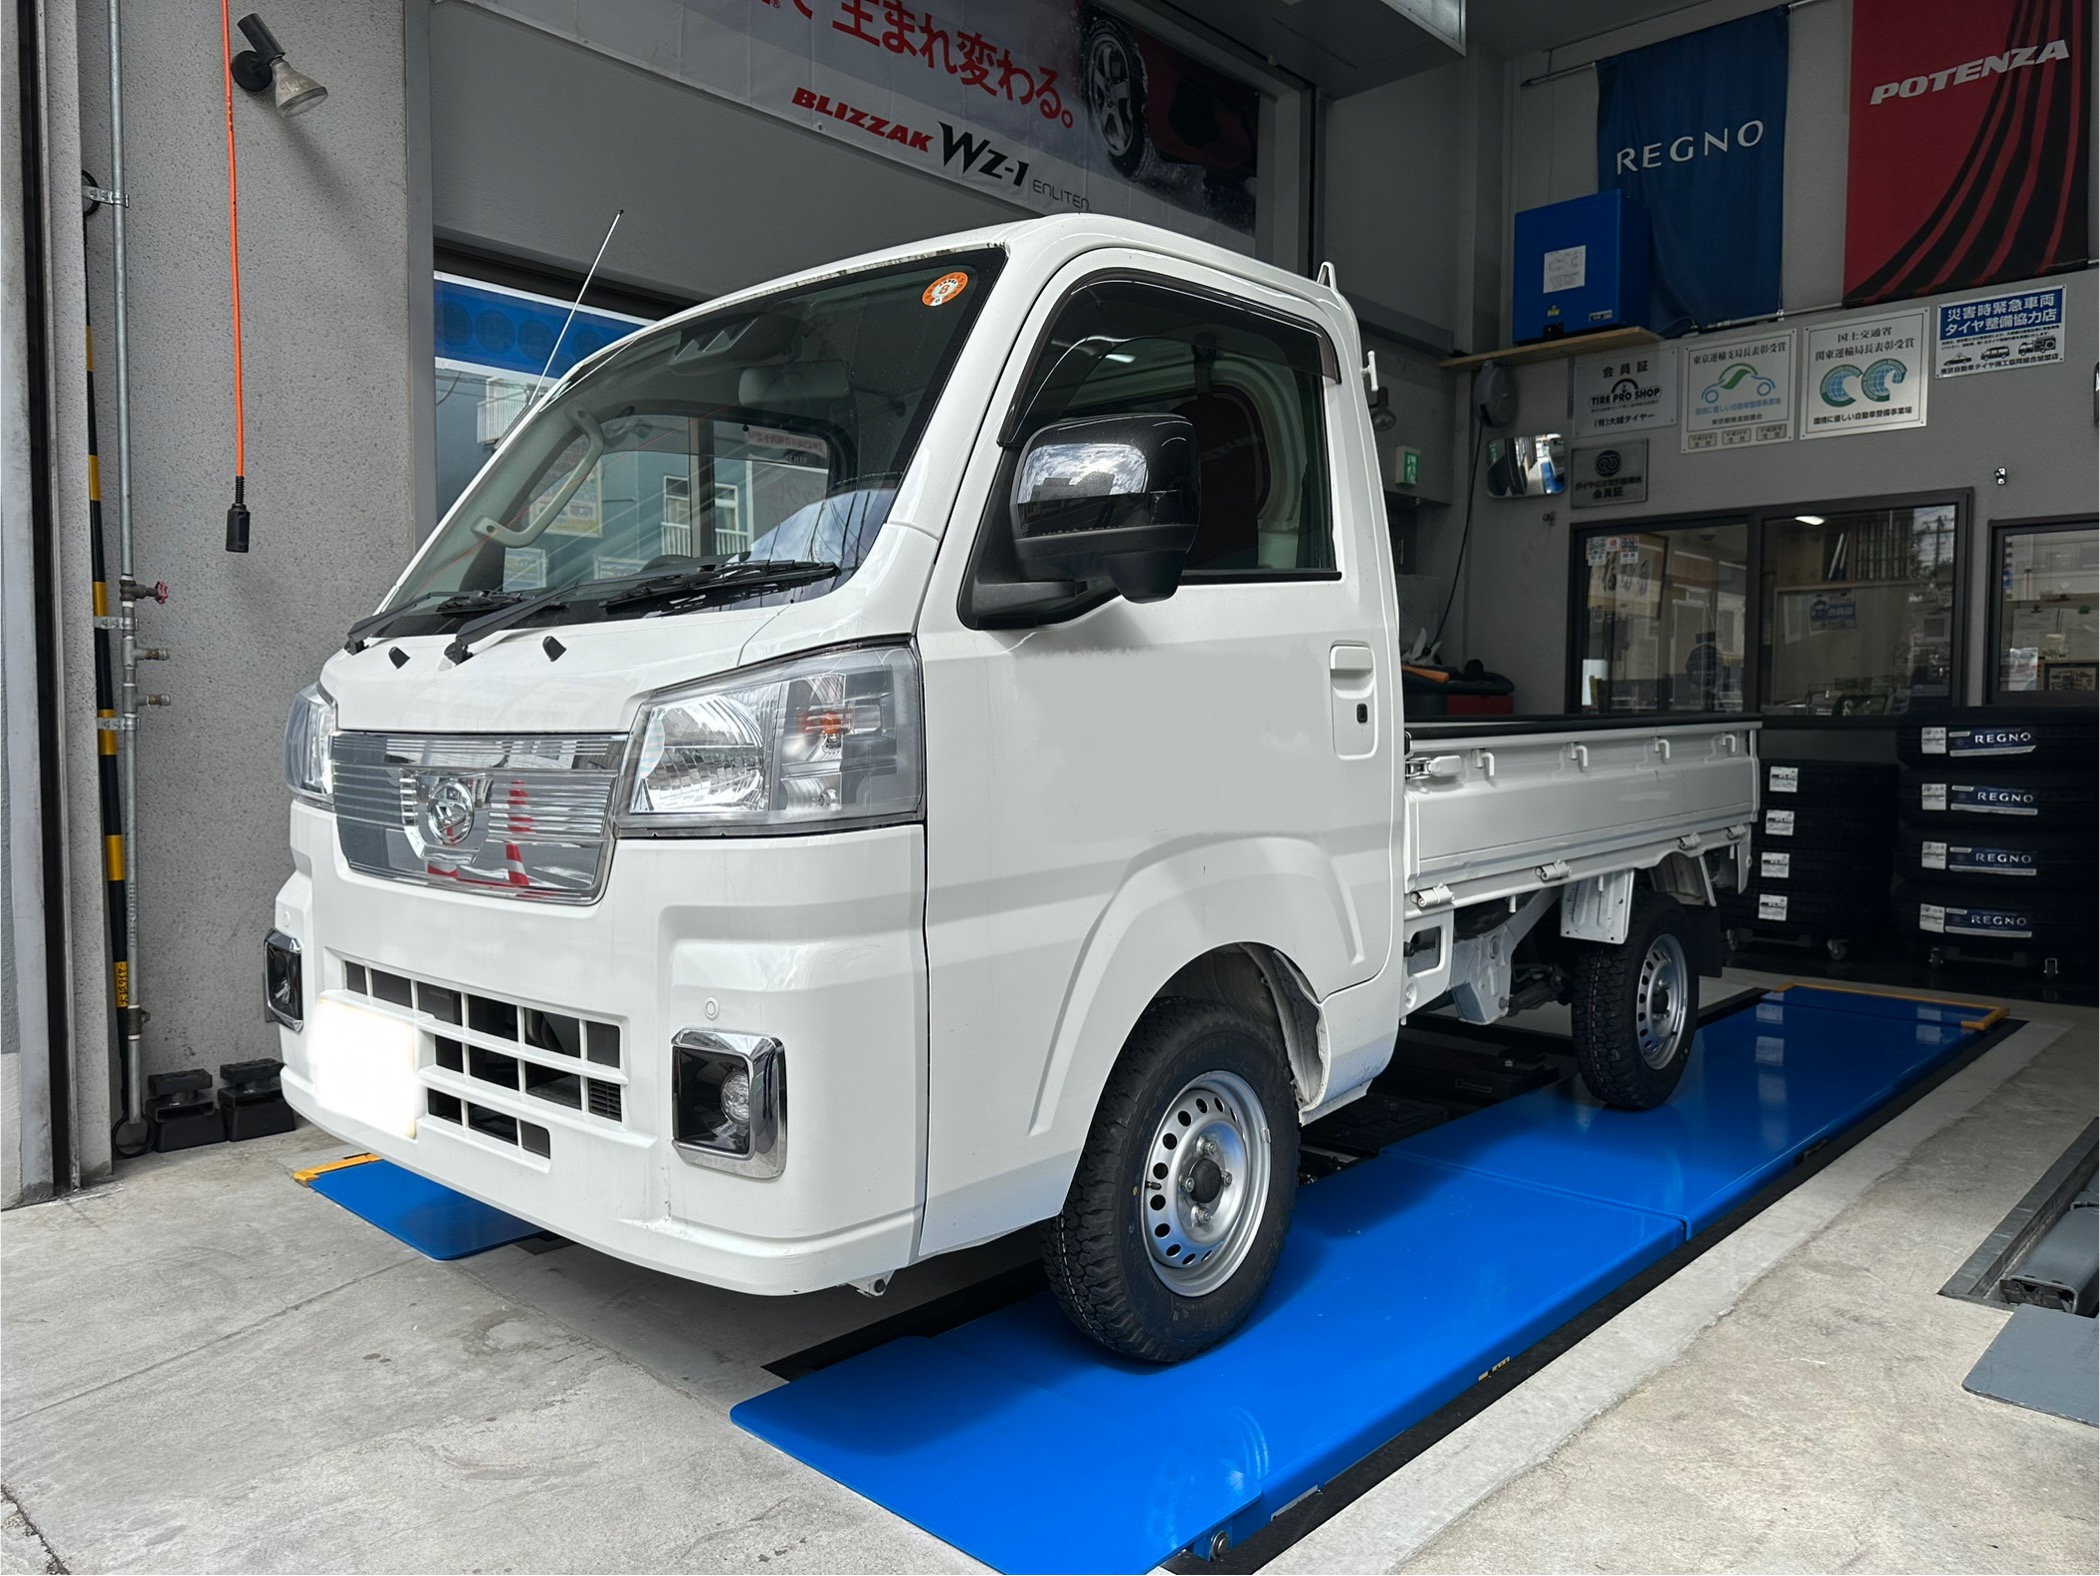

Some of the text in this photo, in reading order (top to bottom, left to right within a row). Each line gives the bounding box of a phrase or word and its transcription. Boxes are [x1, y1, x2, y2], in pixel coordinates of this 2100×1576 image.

[1869, 39, 2070, 105] POTENZA
[791, 87, 933, 152] BLIZZAK
[937, 121, 1029, 187] WZ-1
[1616, 120, 1764, 175] REGNO
[1947, 293, 2055, 322] 災害時緊急車両
[1945, 308, 2058, 337] タイヤ整備協力店
[1837, 326, 1893, 343] 国土交通省
[1815, 338, 1915, 361] 関東運輸局長表彰受賞
[1591, 387, 1660, 406] TIRE PRO SHOP
[1974, 732, 2031, 744] REGNO
[1977, 791, 2034, 803] REGNO
[1975, 852, 2032, 864] REGNO
[1971, 915, 2027, 926] REGNO
